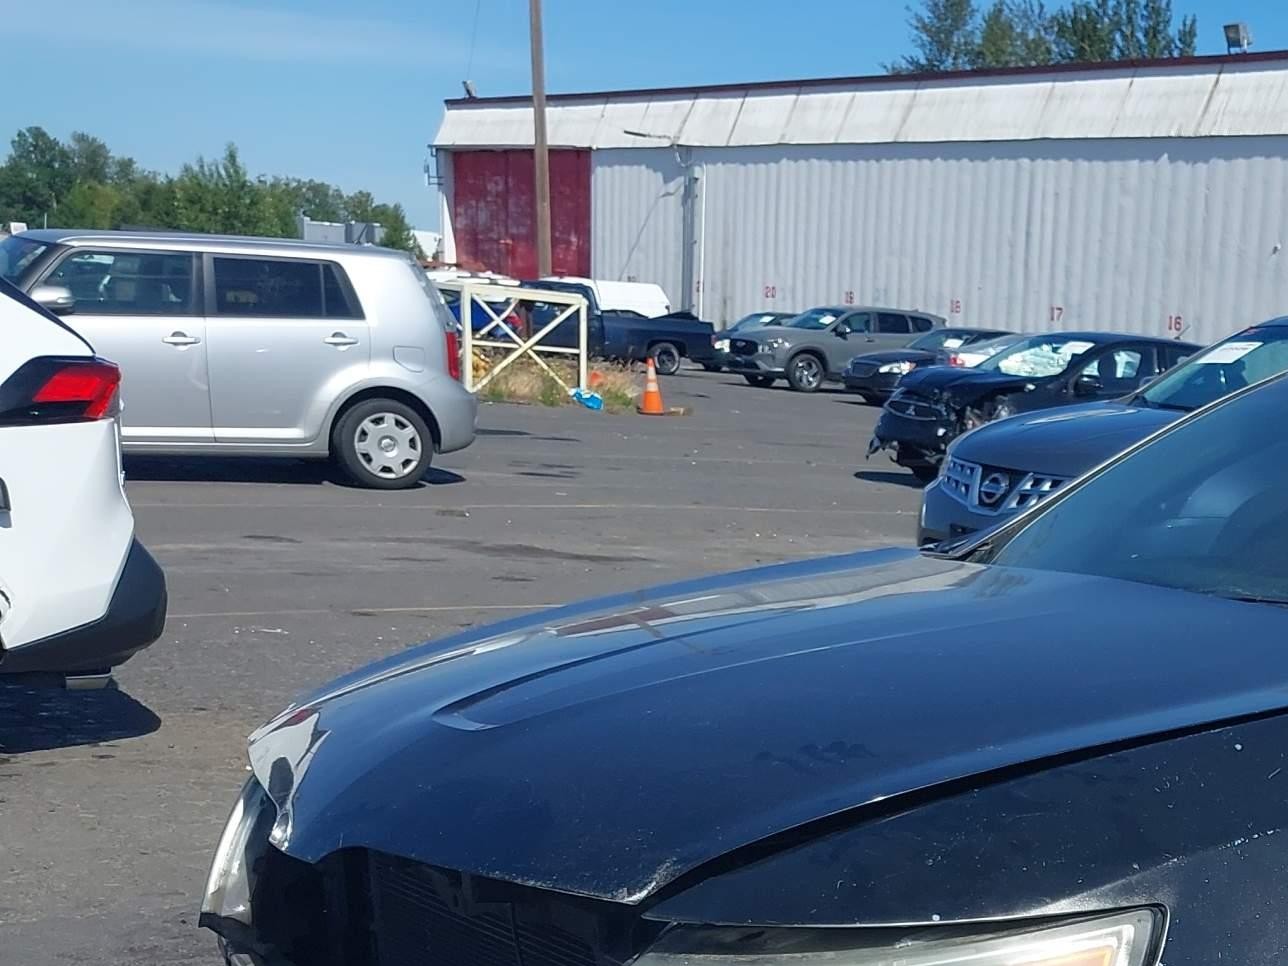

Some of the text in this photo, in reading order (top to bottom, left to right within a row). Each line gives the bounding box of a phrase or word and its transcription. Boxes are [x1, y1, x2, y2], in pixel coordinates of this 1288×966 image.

[765, 286, 776, 299] 20
[951, 300, 960, 313] 18
[1050, 307, 1063, 321] 17
[1168, 316, 1182, 331] 16
